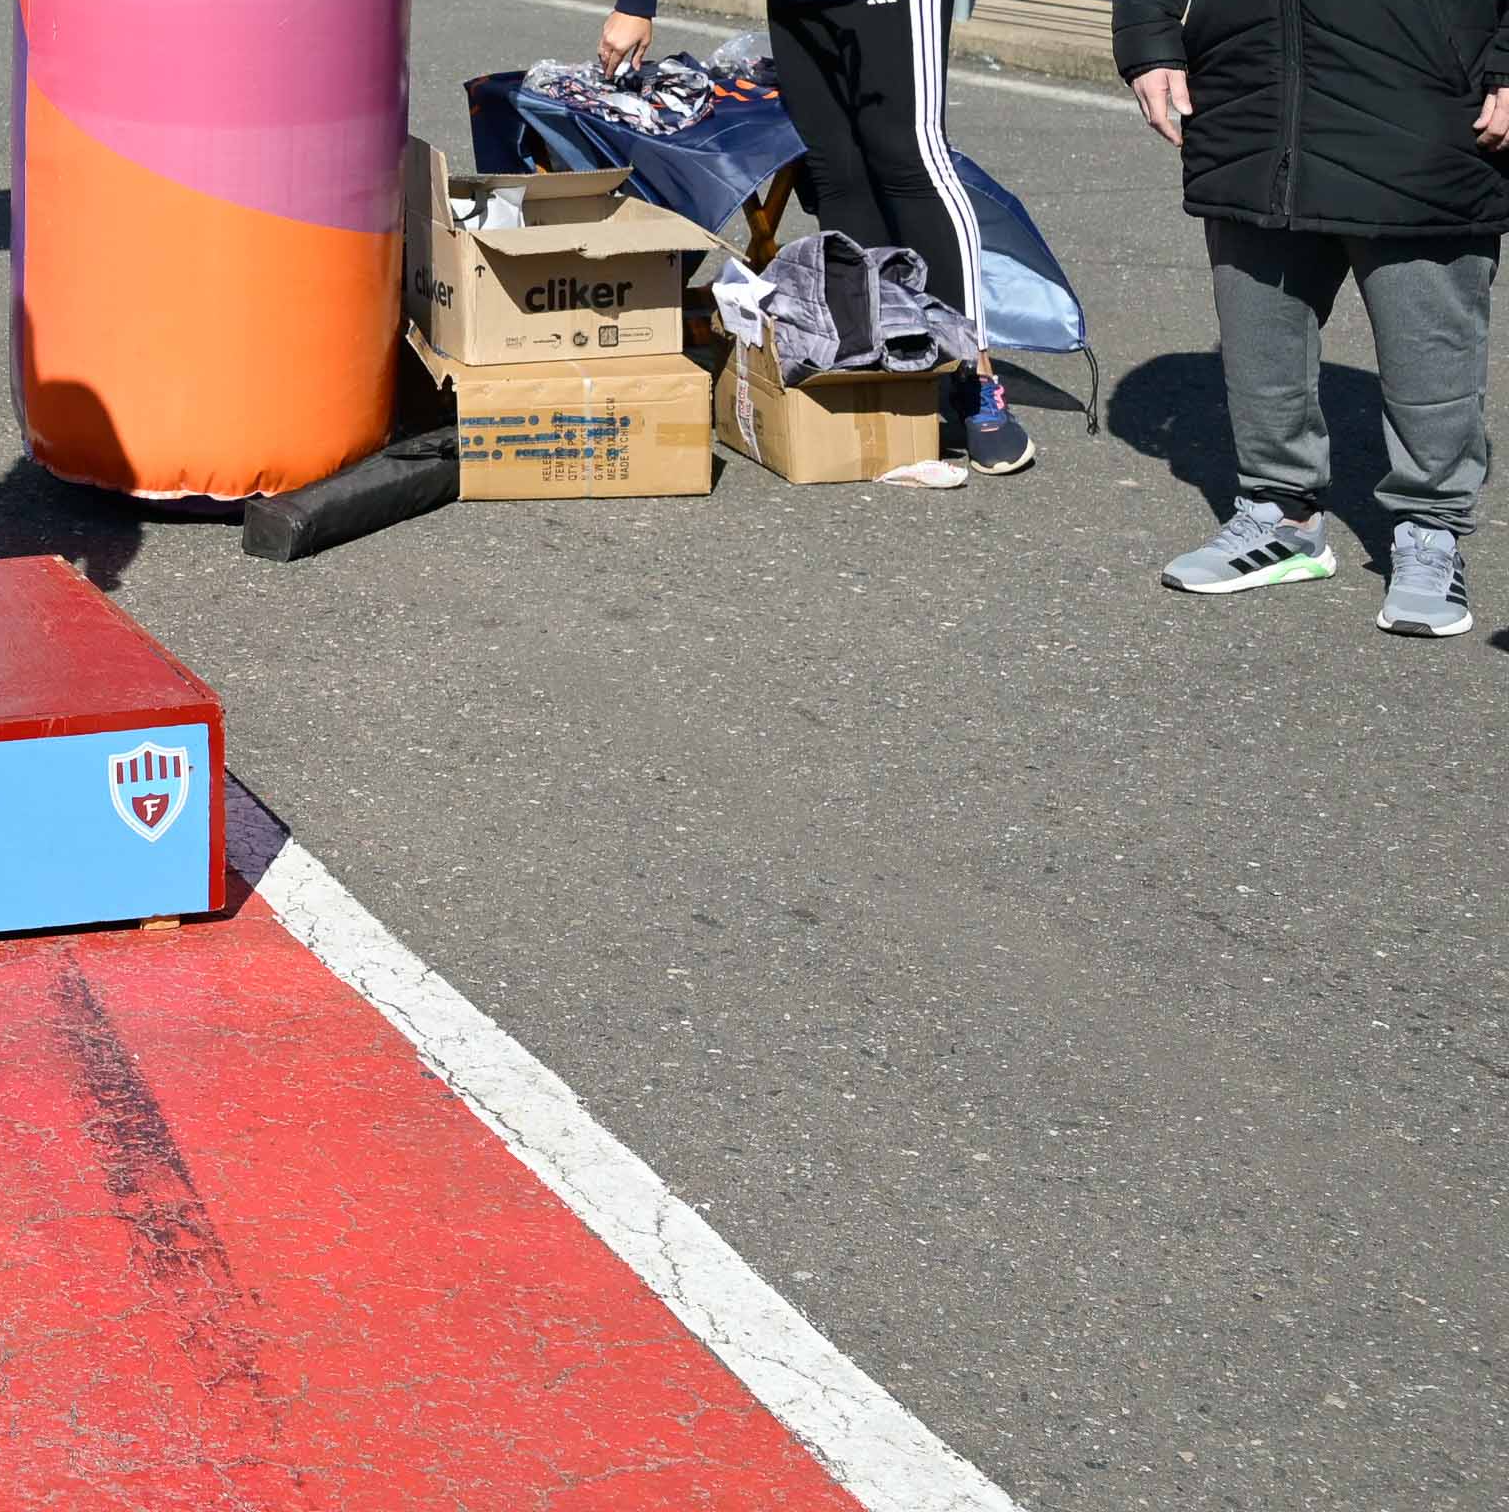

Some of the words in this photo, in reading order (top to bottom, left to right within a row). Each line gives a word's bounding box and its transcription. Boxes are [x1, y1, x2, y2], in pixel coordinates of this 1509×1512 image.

[415, 268, 454, 310] cliker
[524, 278, 634, 314] cliker
[620, 445, 629, 453] IN
[620, 456, 629, 480] MADE
